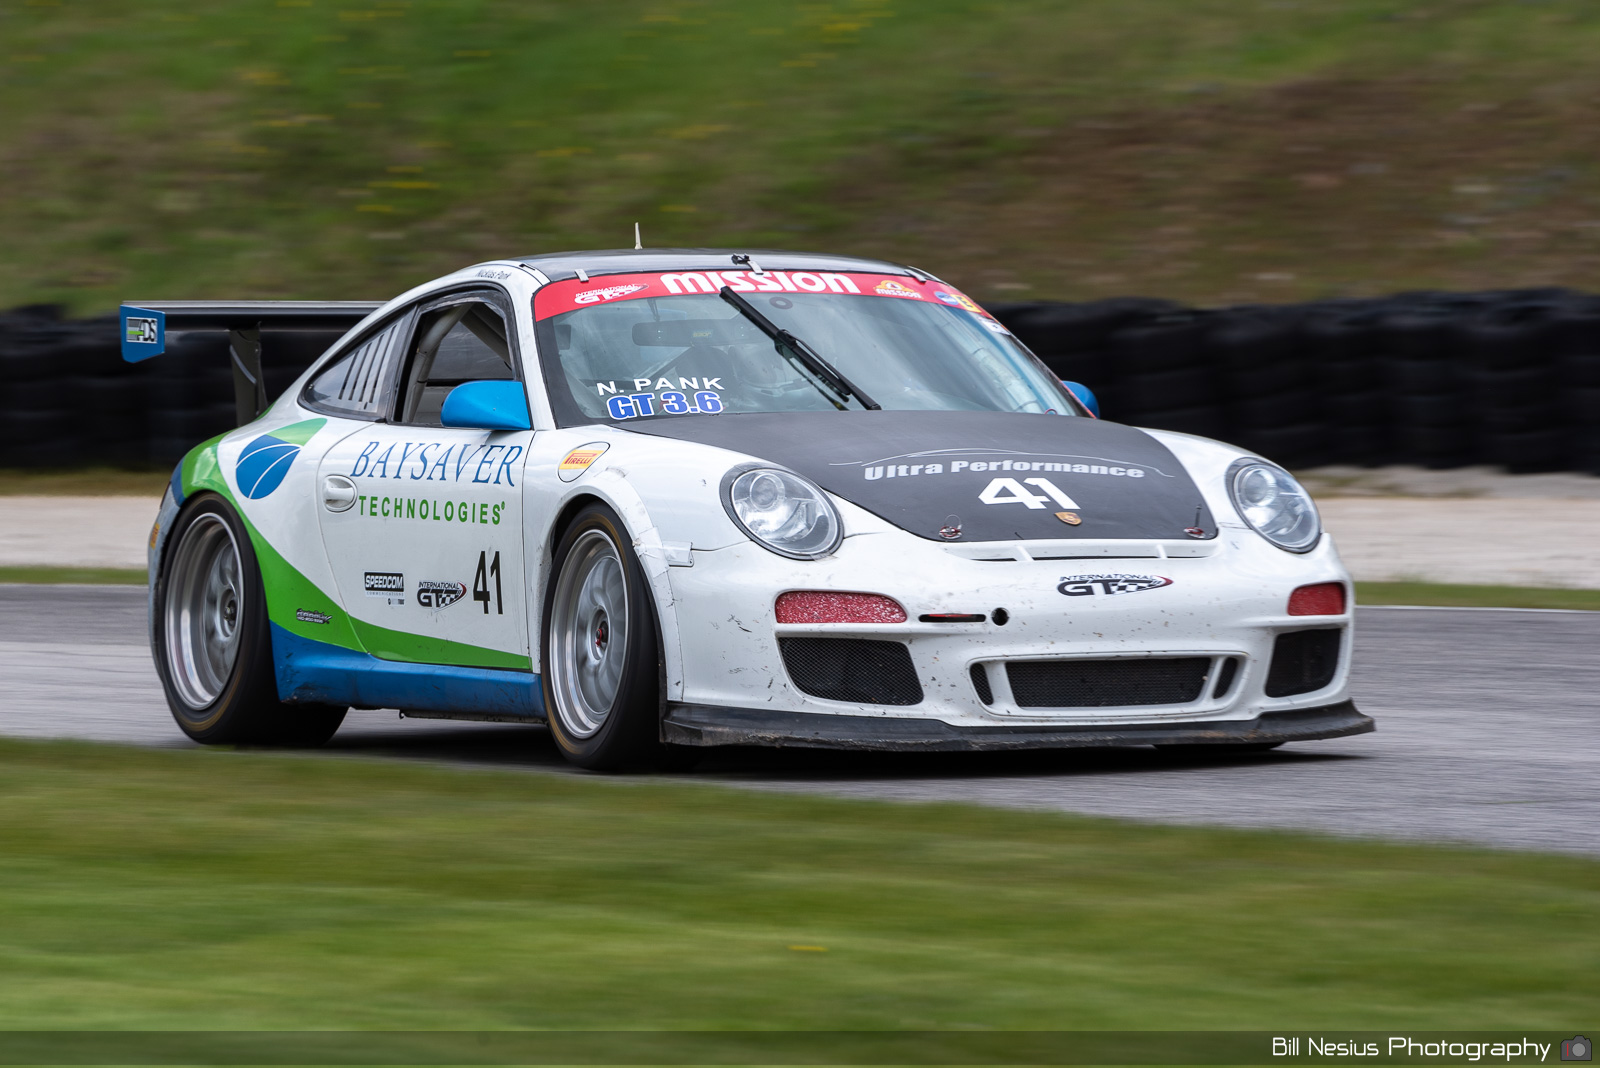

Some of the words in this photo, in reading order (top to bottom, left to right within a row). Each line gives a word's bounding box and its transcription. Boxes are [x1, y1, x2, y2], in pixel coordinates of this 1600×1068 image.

[575, 283, 636, 297] INTERNATIONAL
[596, 381, 624, 396] N.
[633, 377, 725, 392] PANK
[606, 392, 655, 420] GT
[660, 390, 723, 415] 3.6
[350, 441, 523, 487] BAYSAVER
[564, 452, 597, 465] PIRELLI
[864, 461, 943, 481] Ultra
[950, 459, 1146, 478] Performance
[978, 477, 1081, 510] 41
[418, 581, 460, 590] INTERNATIONAL
[473, 550, 503, 615] 41
[1060, 573, 1155, 581] INTERNATIONAL
